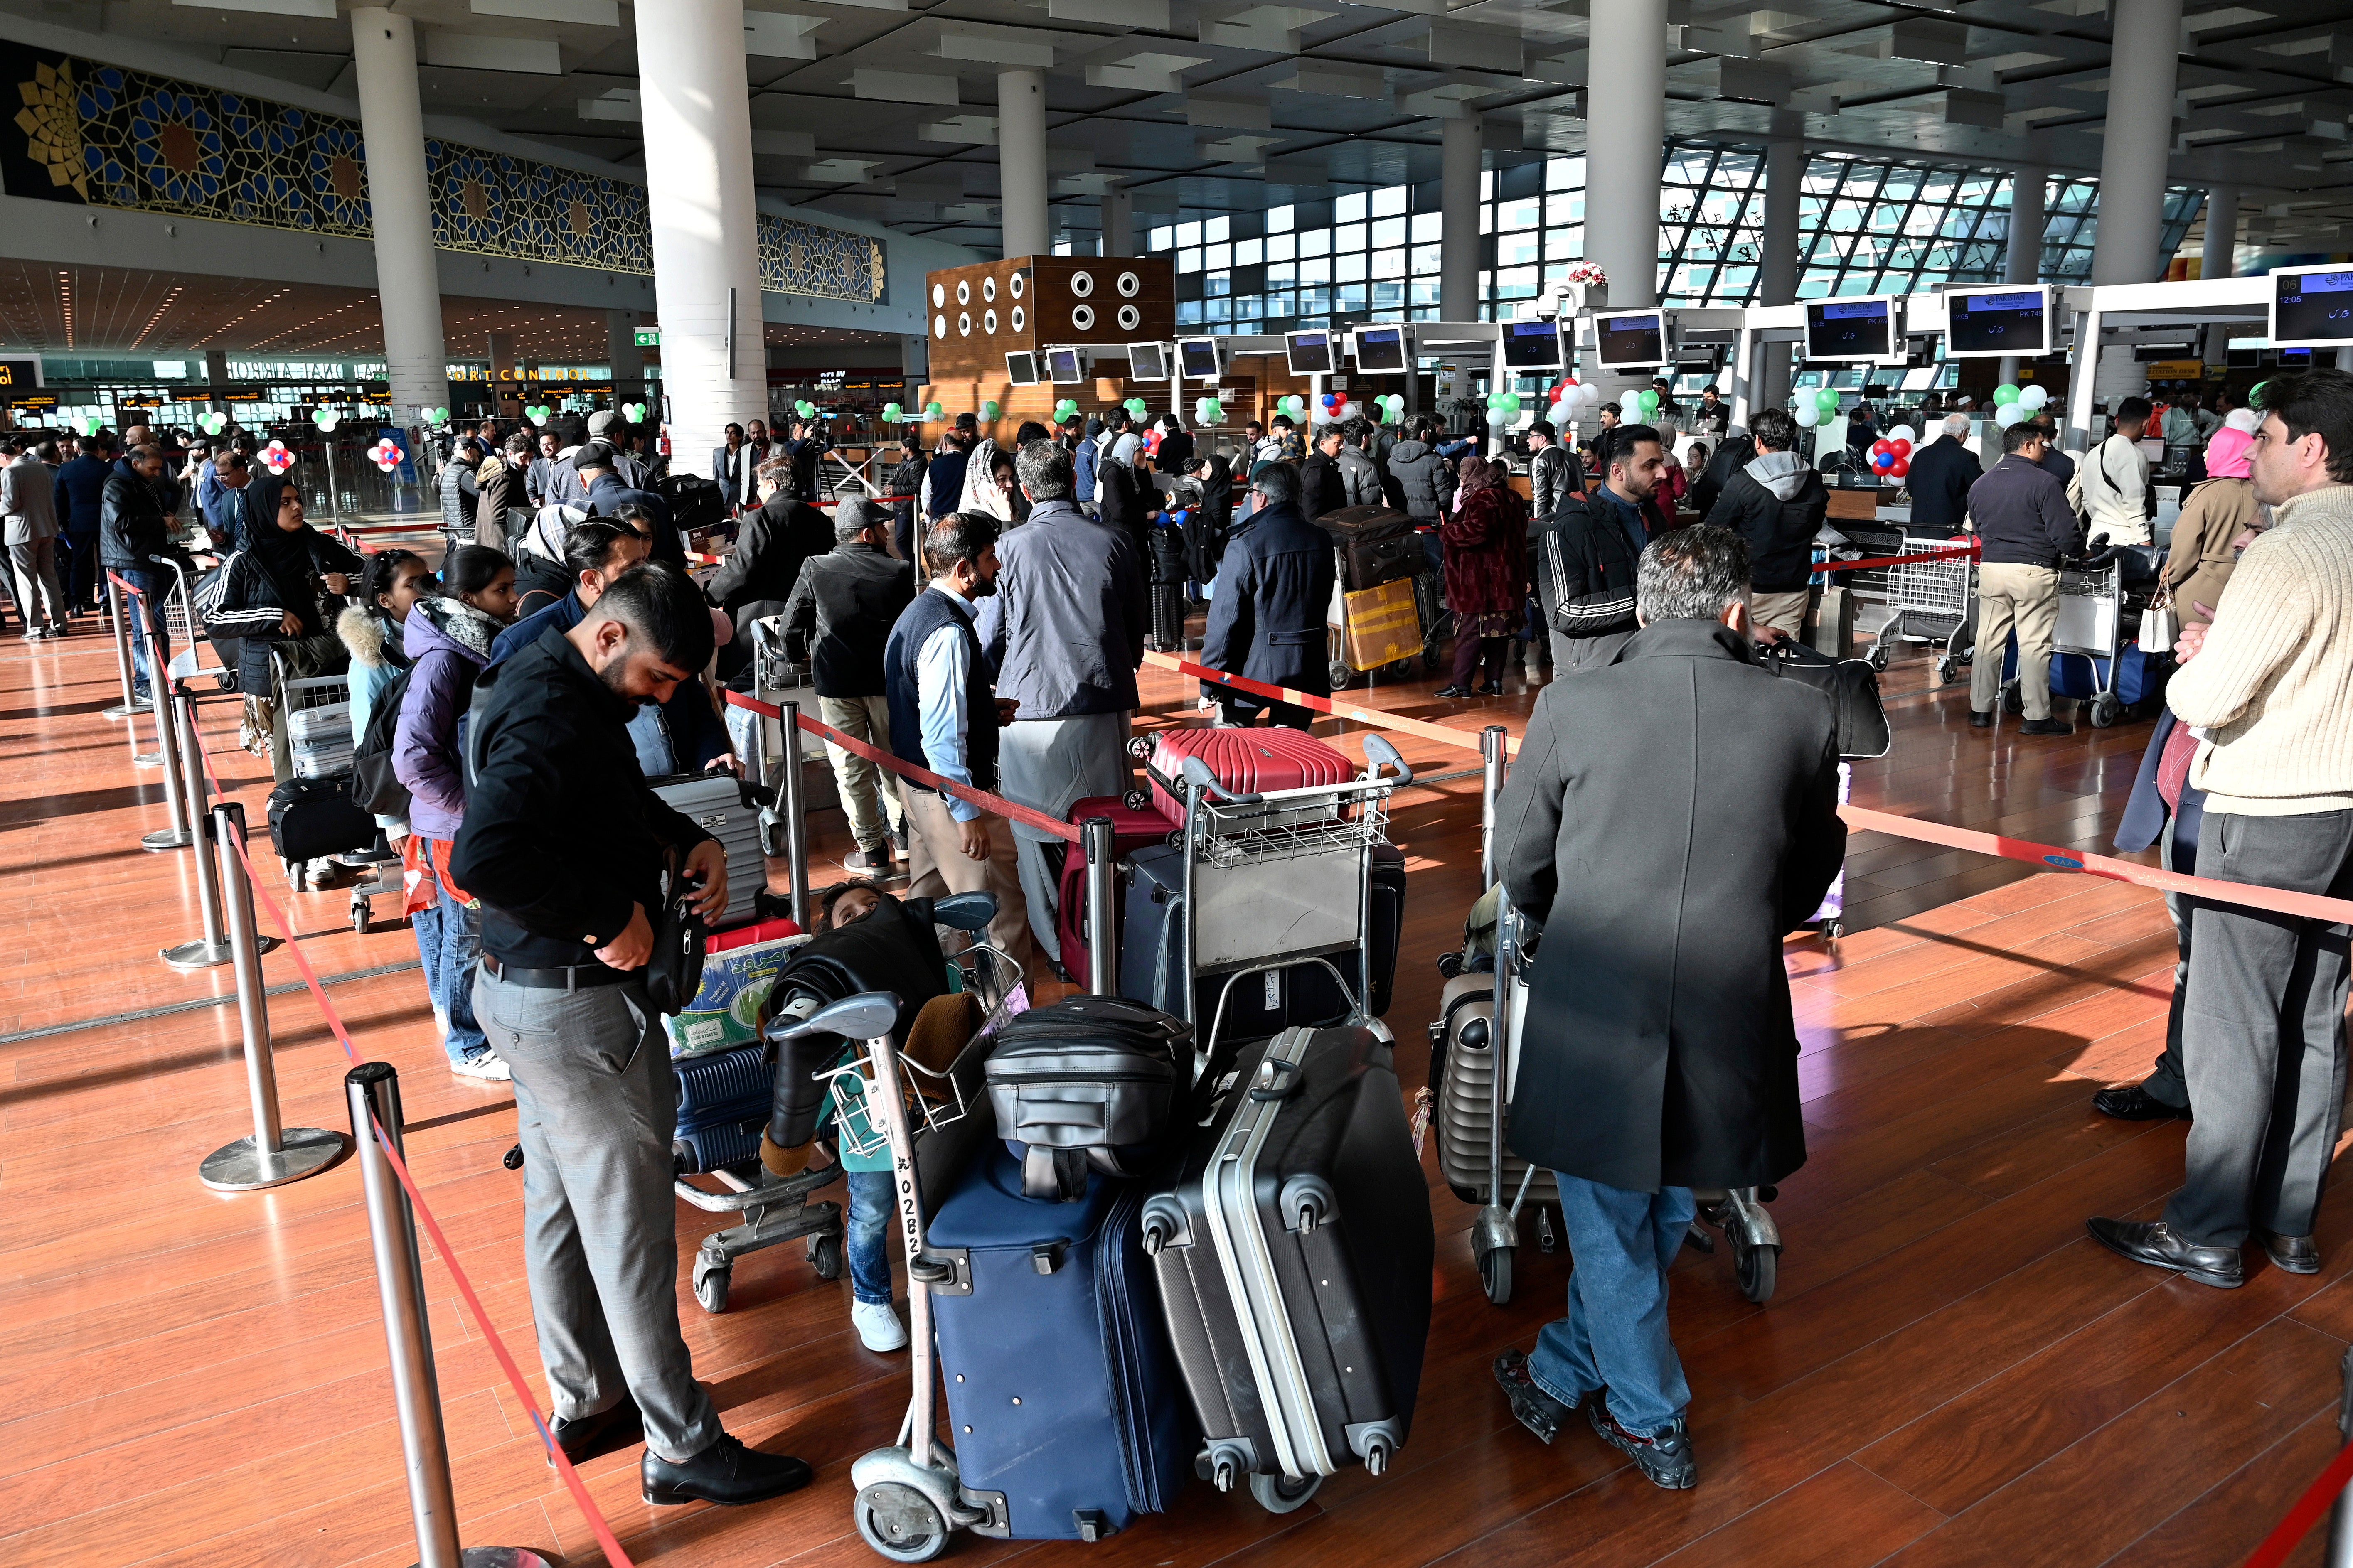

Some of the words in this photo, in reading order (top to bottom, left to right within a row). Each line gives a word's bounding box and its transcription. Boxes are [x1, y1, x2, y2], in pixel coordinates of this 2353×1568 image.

[2282, 280, 2297, 290] 06
[1954, 300, 1964, 309] 07
[448, 370, 492, 381] ORT
[500, 369, 590, 381] CONTROL
[1890, 626, 1899, 636] 060
[2159, 873, 2171, 885] سول
[2171, 877, 2198, 891] پاکستان
[732, 949, 790, 974] امرود
[708, 986, 723, 1002] Product
[715, 987, 730, 1004] Pakistan
